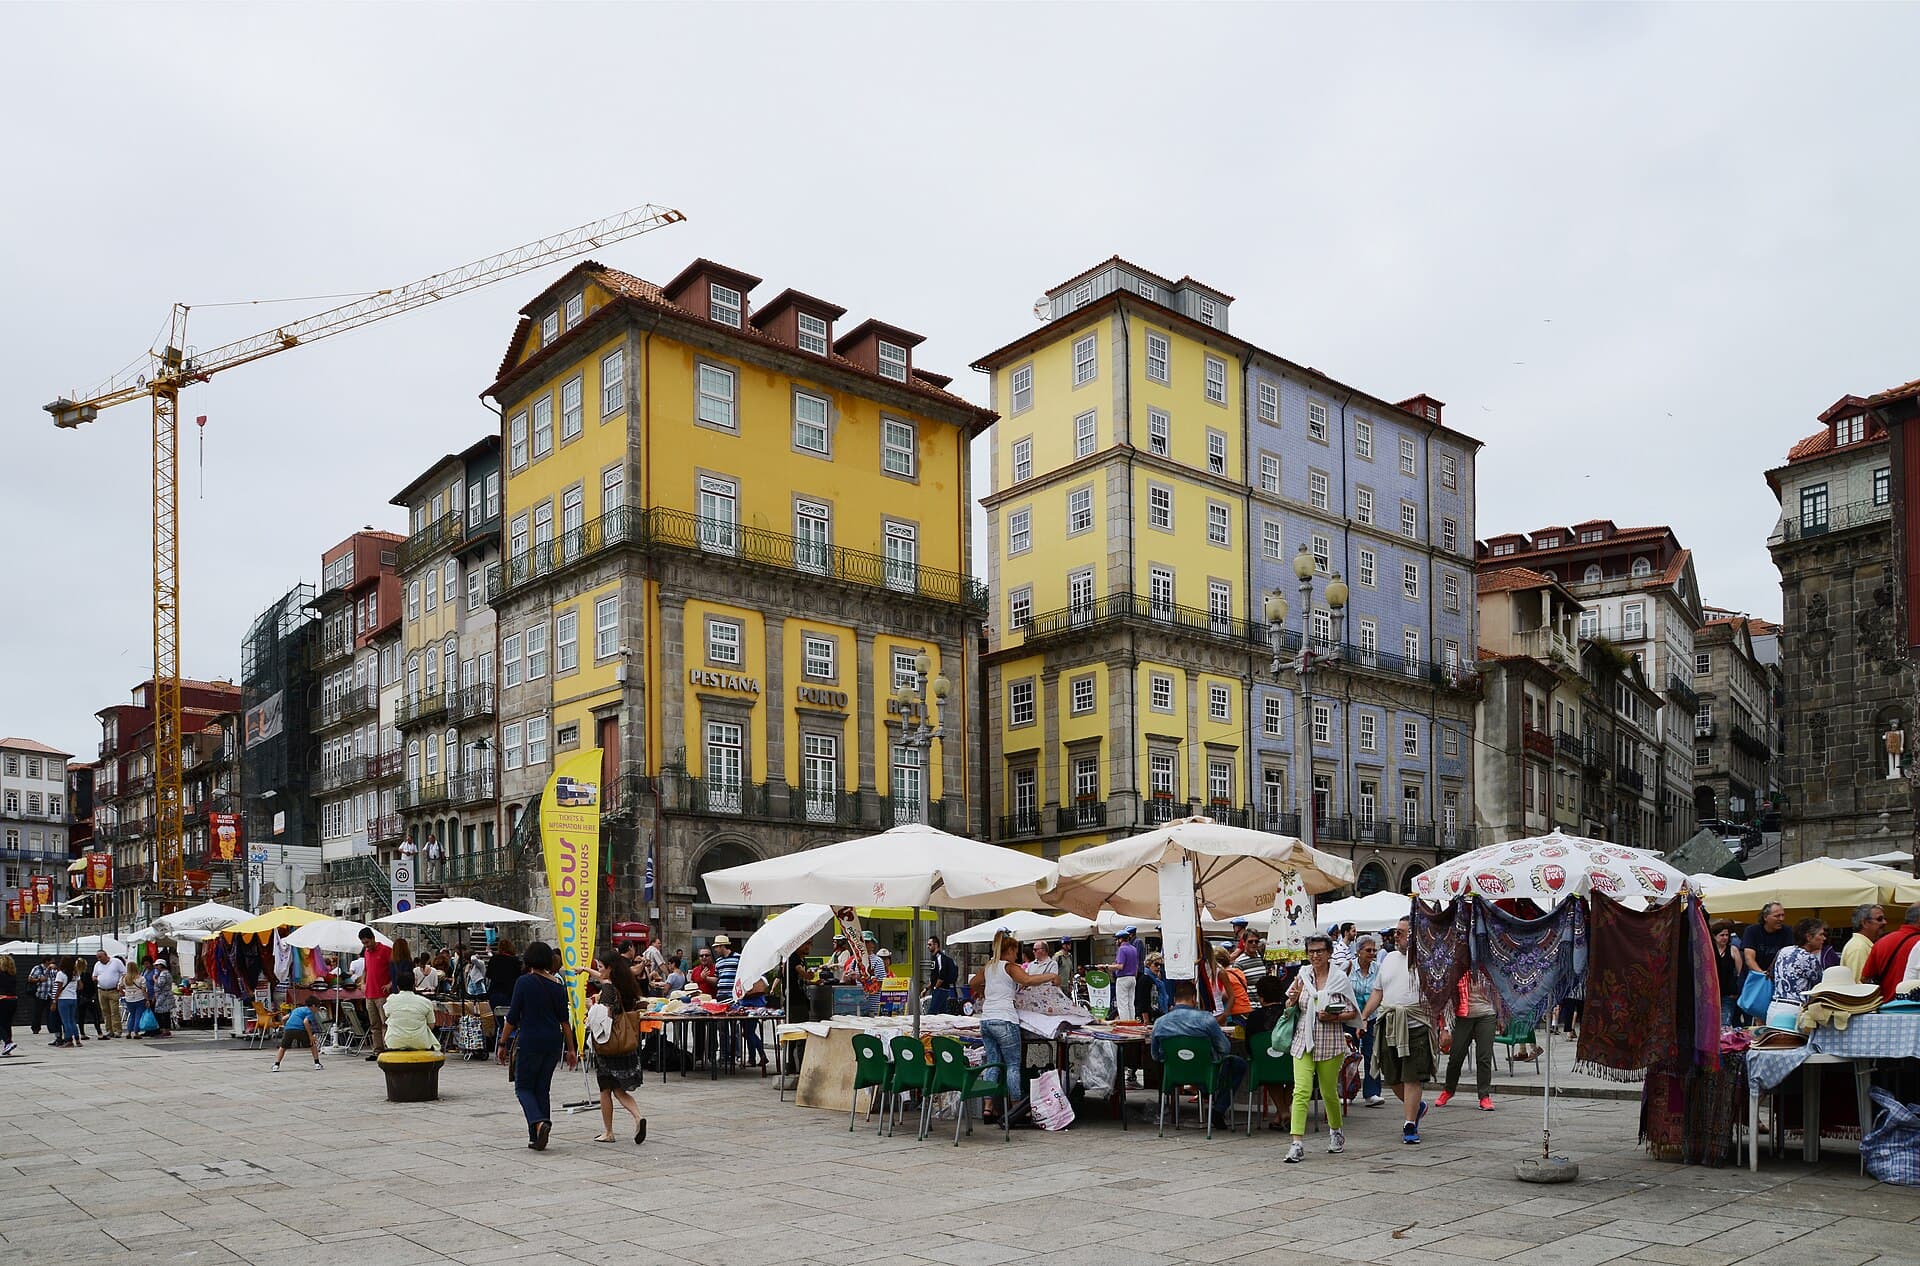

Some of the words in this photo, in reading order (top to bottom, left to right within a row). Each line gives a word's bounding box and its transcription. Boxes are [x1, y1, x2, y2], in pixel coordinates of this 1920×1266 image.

[690, 669, 761, 693] PESTANA
[797, 686, 849, 708] PORTO
[398, 871, 407, 879] 20
[556, 837, 577, 898] bus
[580, 843, 590, 886] TOURS
